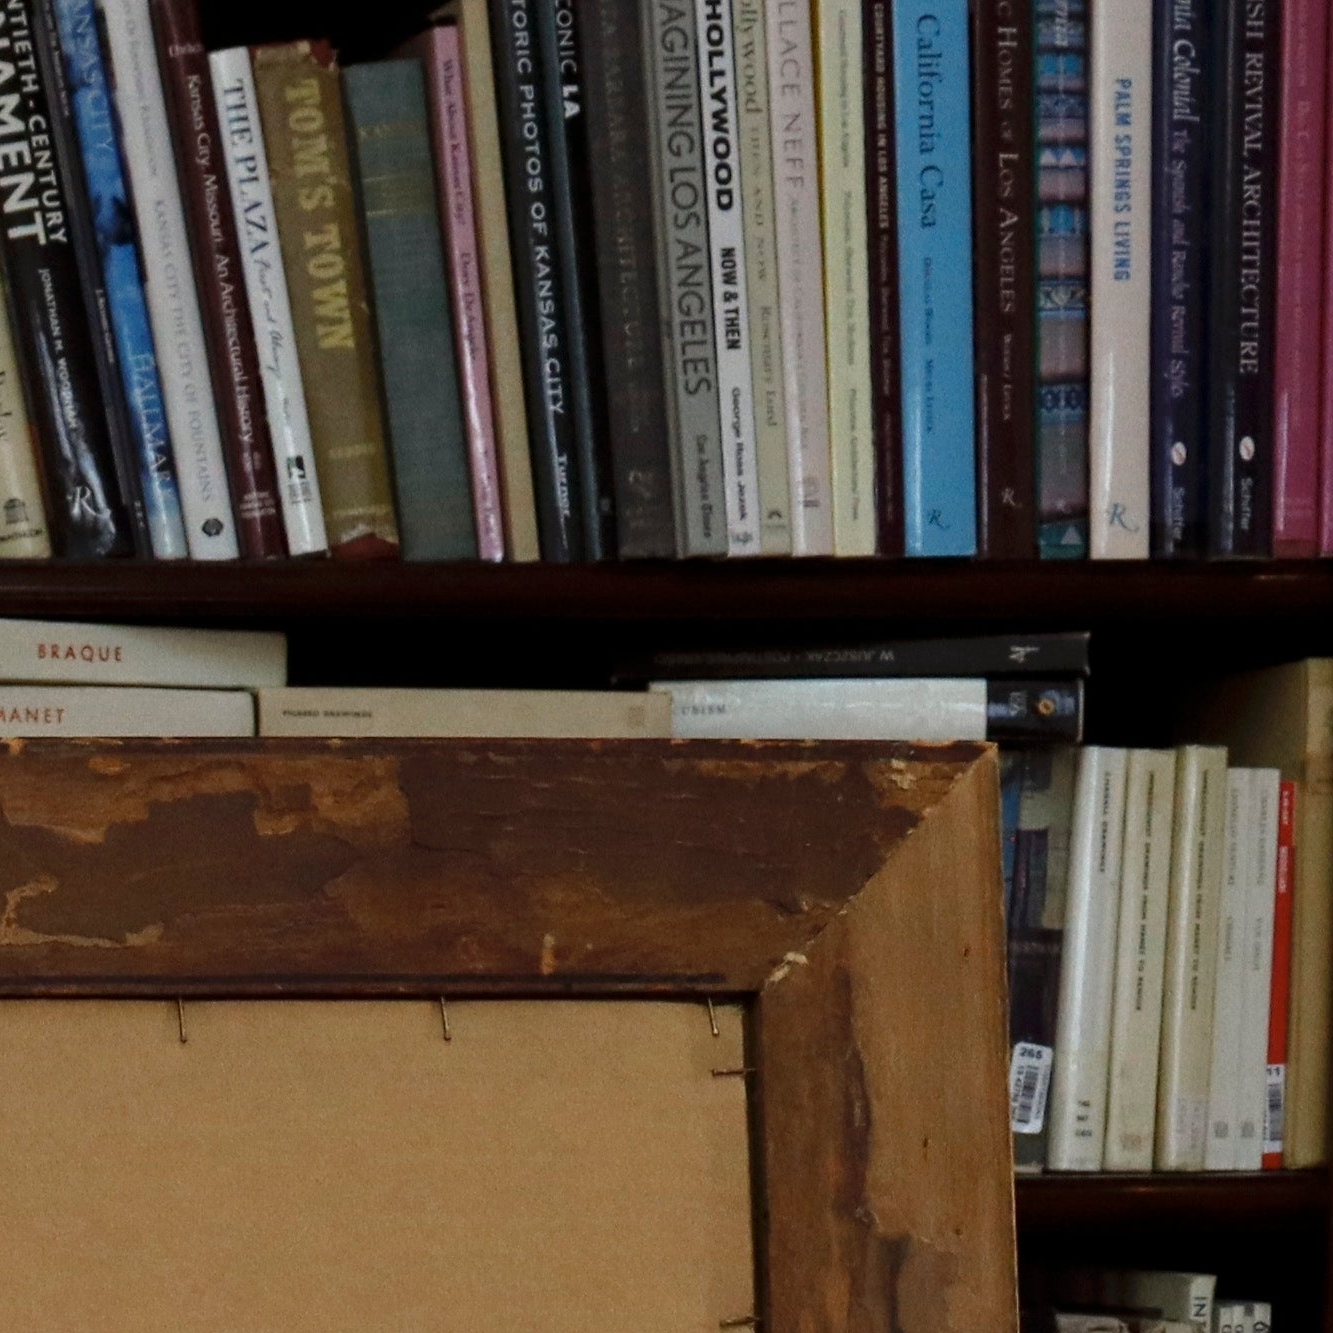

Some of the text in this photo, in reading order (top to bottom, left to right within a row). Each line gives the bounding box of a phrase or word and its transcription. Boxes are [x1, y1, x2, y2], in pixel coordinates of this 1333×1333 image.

[562, 84, 581, 119] LA
[917, 13, 944, 156] California
[1171, 38, 1201, 123] Colonial
[28, 113, 68, 245] CENTURY
[223, 77, 271, 254] THE PLAZA
[284, 77, 356, 349] TOM'S TOWN
[668, 167, 701, 232] LOS
[704, 0, 742, 352] HOLLYWOOD NOW & THEN
[783, 112, 806, 189] NEFF
[918, 164, 945, 230] Casa
[1113, 78, 1133, 282] PALM SPRINGS LIVING
[1240, 52, 1265, 375] REVIVAL ARCHITECTURE
[519, 84, 565, 417] PHOTOS OF KANSAS CITY
[675, 239, 712, 397] ANGELES
[219, 281, 247, 383] Architectural
[37, 643, 123, 662] BRAQUE
